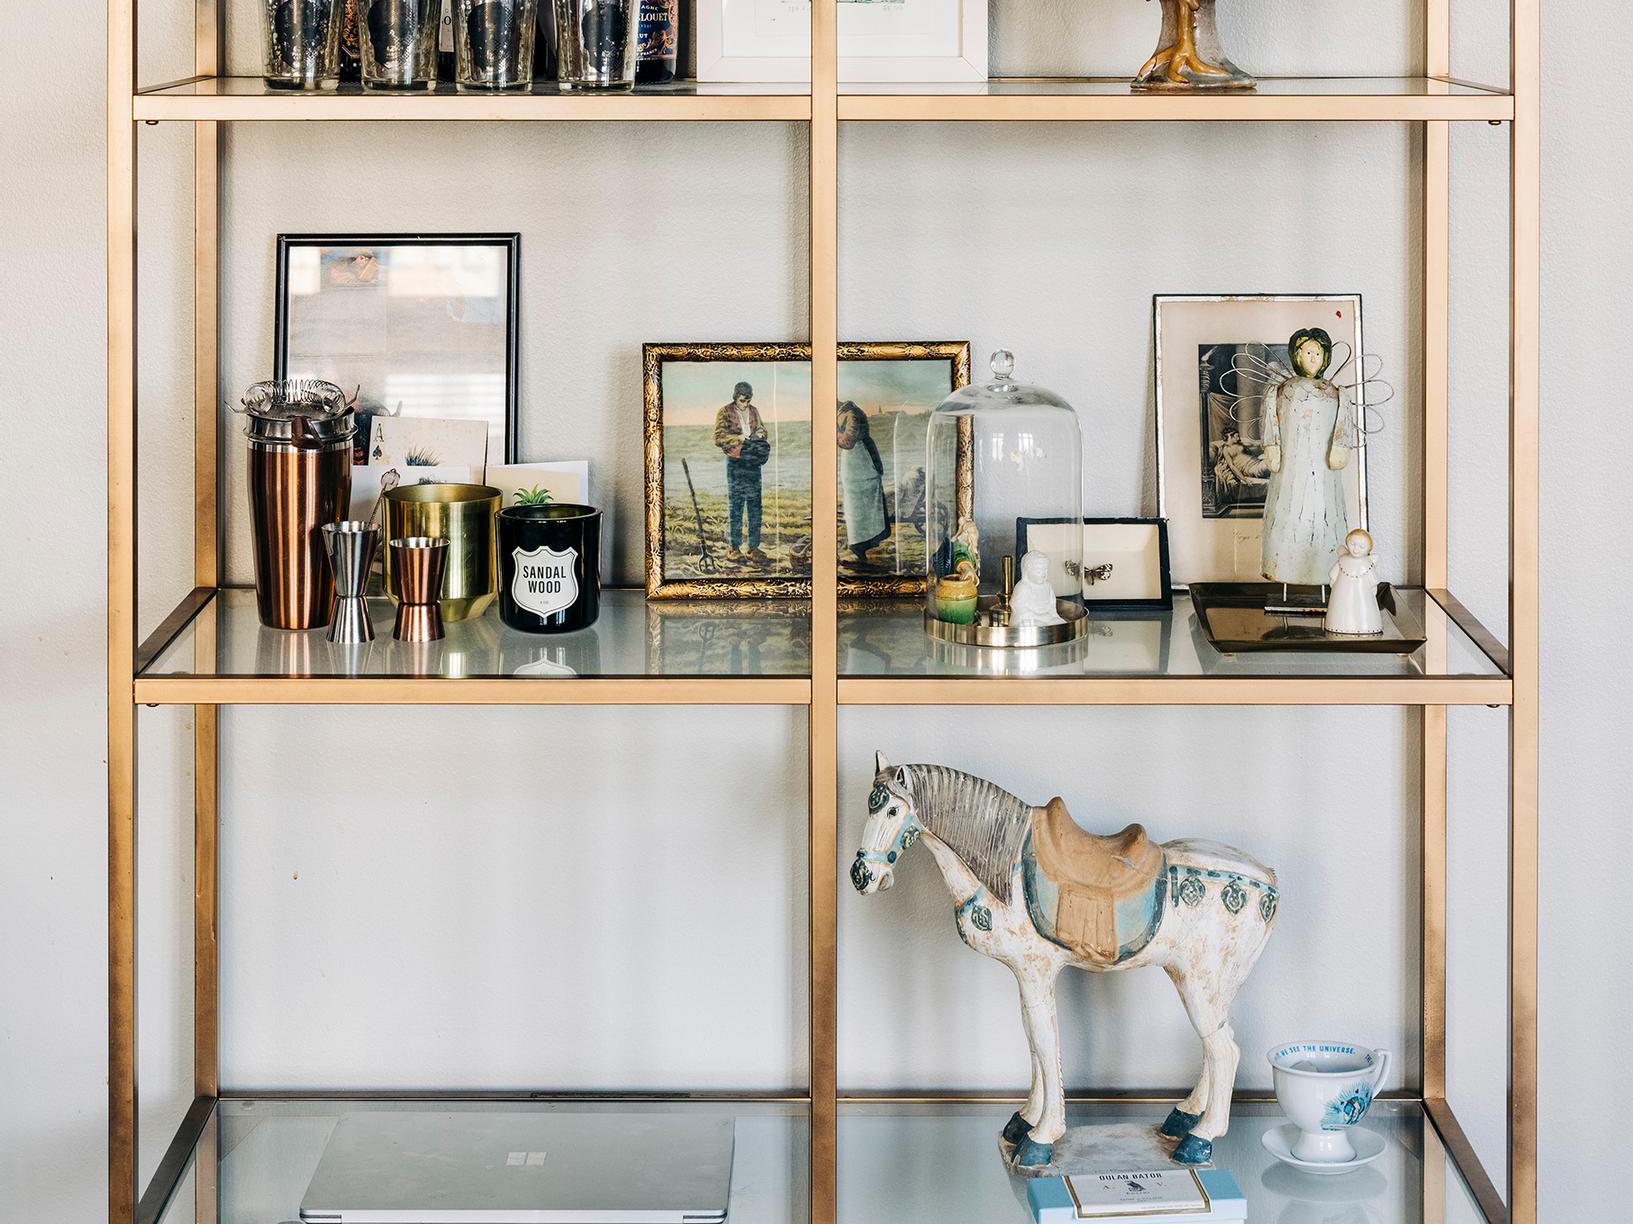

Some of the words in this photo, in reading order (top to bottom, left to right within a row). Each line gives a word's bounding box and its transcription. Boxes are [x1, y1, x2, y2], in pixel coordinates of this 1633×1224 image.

[639, 12, 668, 22] LOUET
[373, 423, 385, 442] A
[523, 565, 567, 579] SANDAL
[528, 580, 561, 594] WOOD
